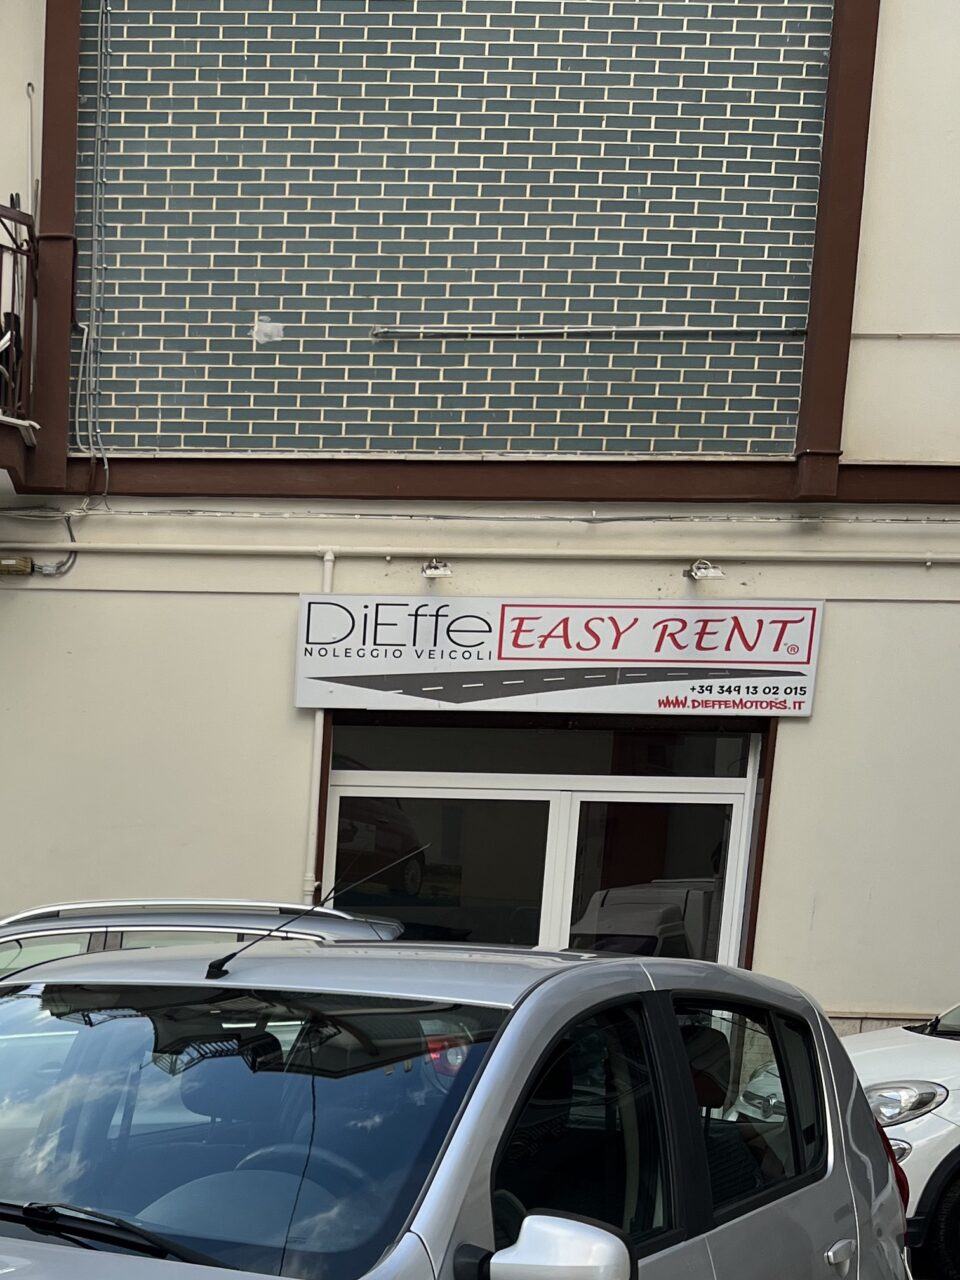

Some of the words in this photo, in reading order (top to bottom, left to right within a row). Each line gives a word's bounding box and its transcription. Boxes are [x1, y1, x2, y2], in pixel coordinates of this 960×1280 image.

[306, 601, 493, 648] DiEffe
[510, 616, 639, 651] EASY
[303, 647, 403, 659] NOLEGGIO
[414, 649, 492, 661] VEICOLI
[690, 685, 713, 695] +39
[717, 685, 741, 696] 349
[745, 686, 758, 696] 13
[762, 686, 780, 696] 02
[783, 686, 807, 696] 015
